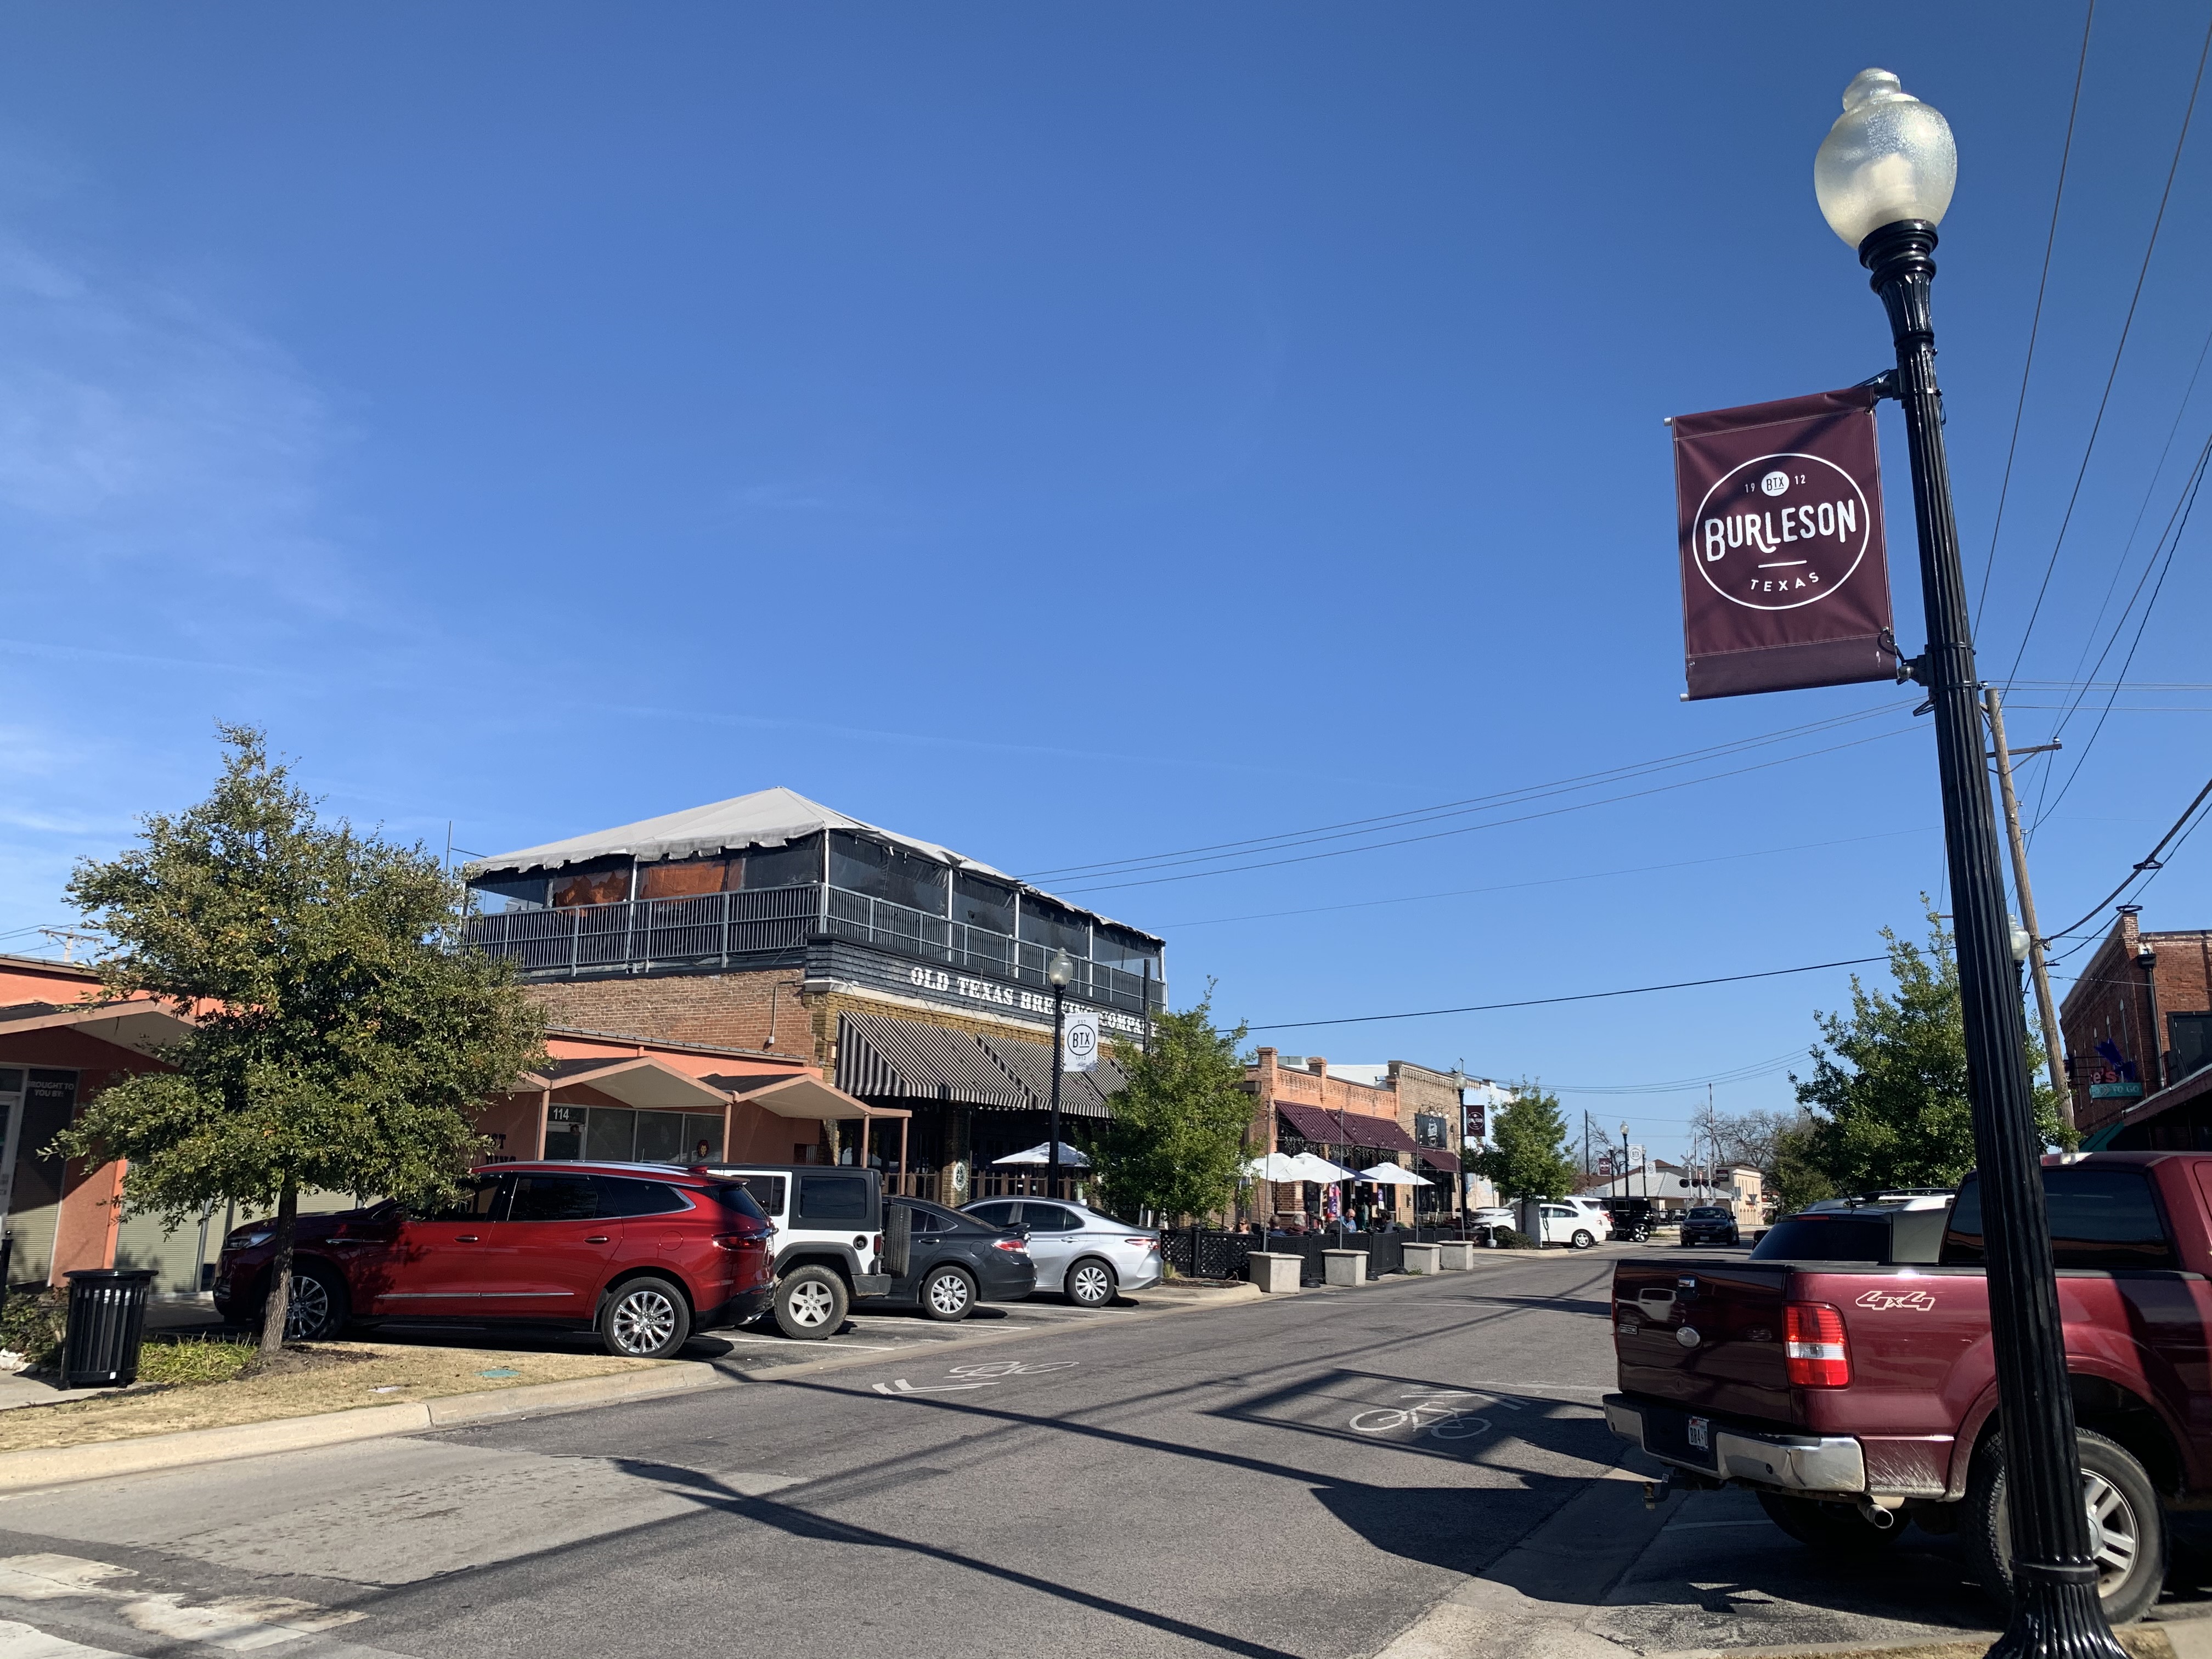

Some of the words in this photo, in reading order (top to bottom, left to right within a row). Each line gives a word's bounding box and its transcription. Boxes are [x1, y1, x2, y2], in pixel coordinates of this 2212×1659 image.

[1745, 483, 1756, 493] 19
[1766, 476, 1784, 491] BTX
[1795, 475, 1805, 485] 12
[1705, 499, 1857, 562] BURLESON
[1750, 572, 1819, 592] TEXAS
[910, 967, 950, 991] OLD
[957, 976, 1014, 1006] TEXAS
[1073, 1032, 1090, 1048] BTX
[553, 1107, 569, 1120] 114
